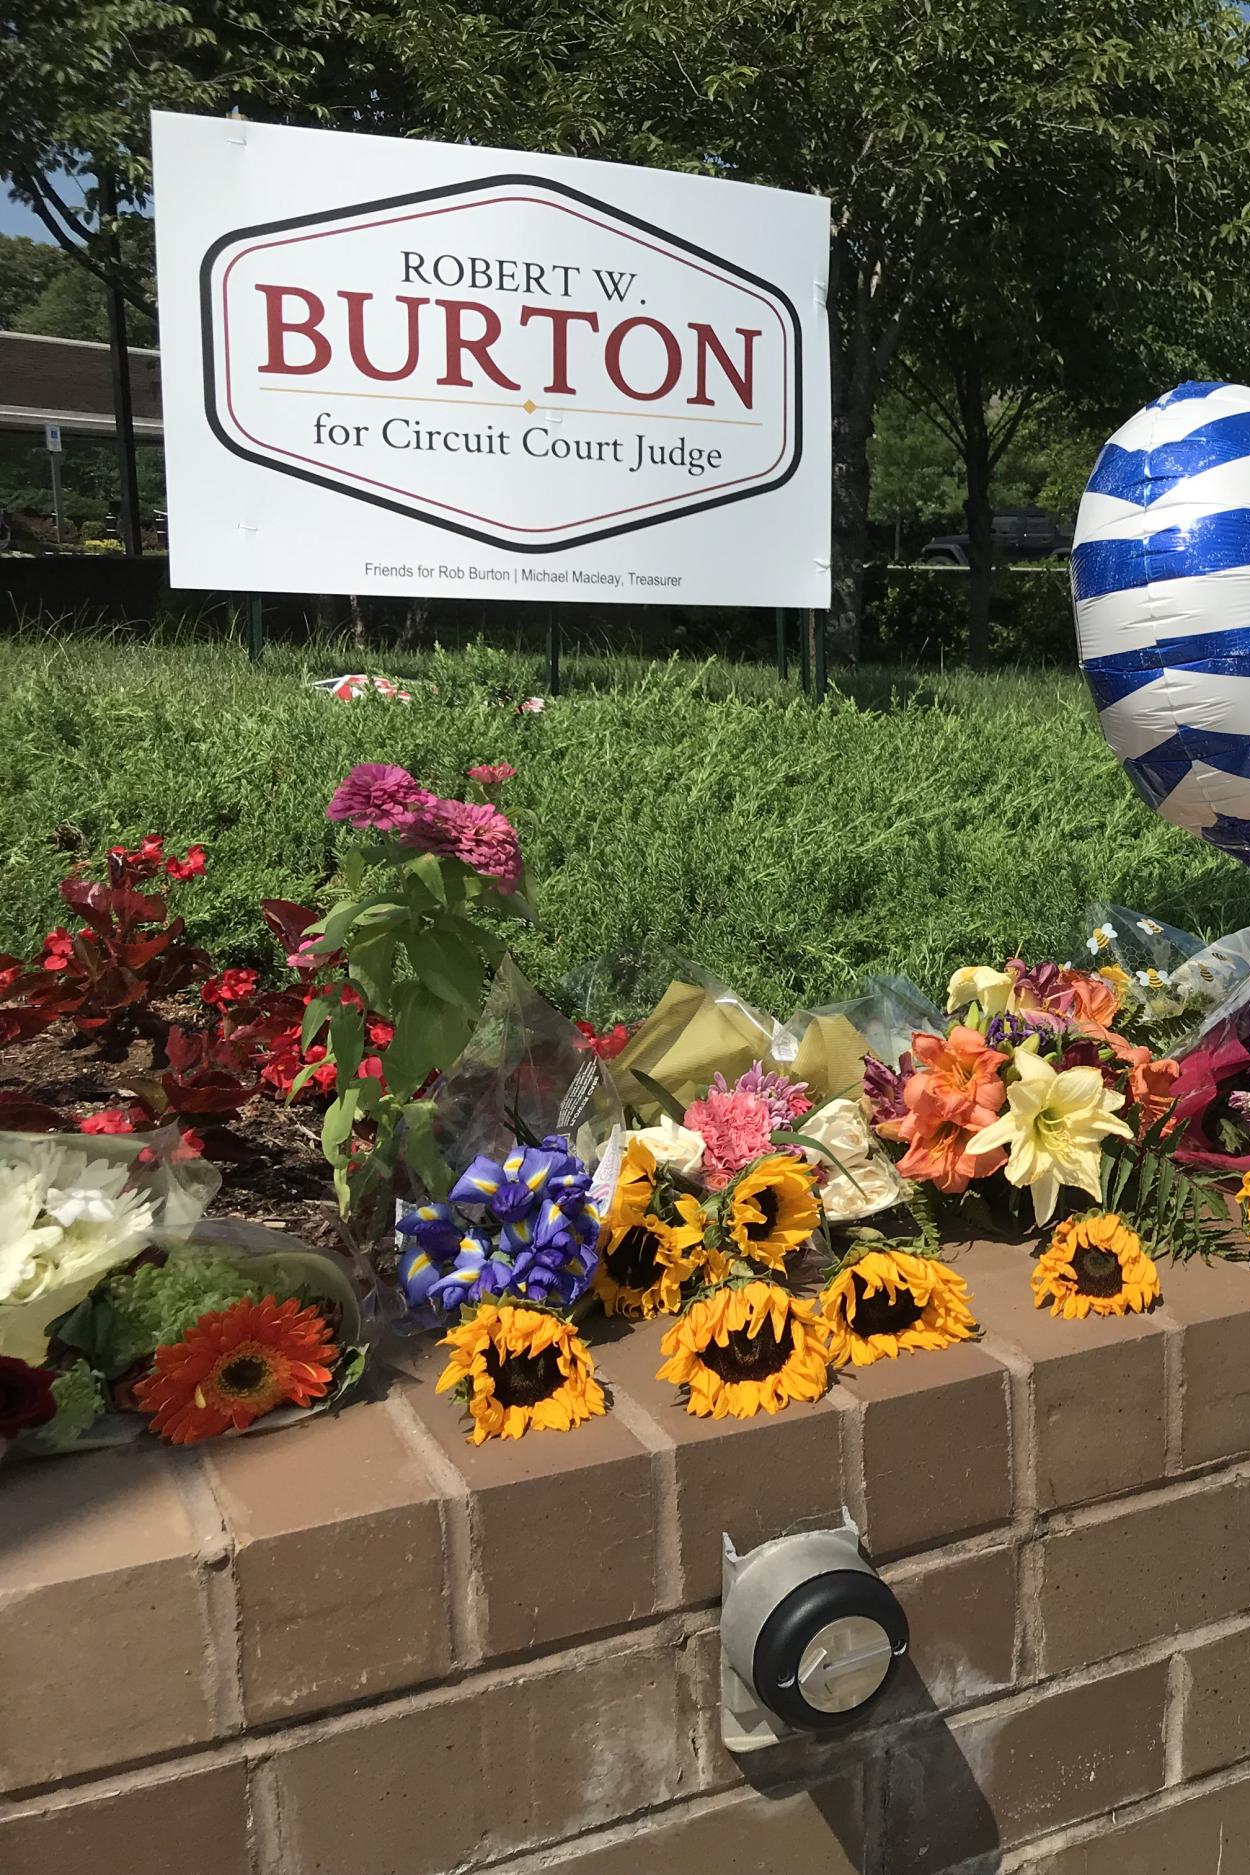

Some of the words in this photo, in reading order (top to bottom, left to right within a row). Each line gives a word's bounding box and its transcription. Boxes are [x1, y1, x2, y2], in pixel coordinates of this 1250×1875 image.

[400, 250, 581, 298] ROBERT
[592, 269, 647, 306] W.
[255, 283, 763, 410] BURTON
[313, 412, 370, 447] for
[382, 418, 511, 455] Circuit
[522, 427, 624, 463] Court
[629, 434, 723, 477] Judge
[364, 562, 414, 578] Friends
[417, 564, 435, 578] for
[438, 565, 465, 579] Rob
[468, 566, 510, 581] Burton
[521, 568, 569, 584] Michael
[572, 570, 624, 588] Macleay,
[627, 572, 683, 587] Treasurer
